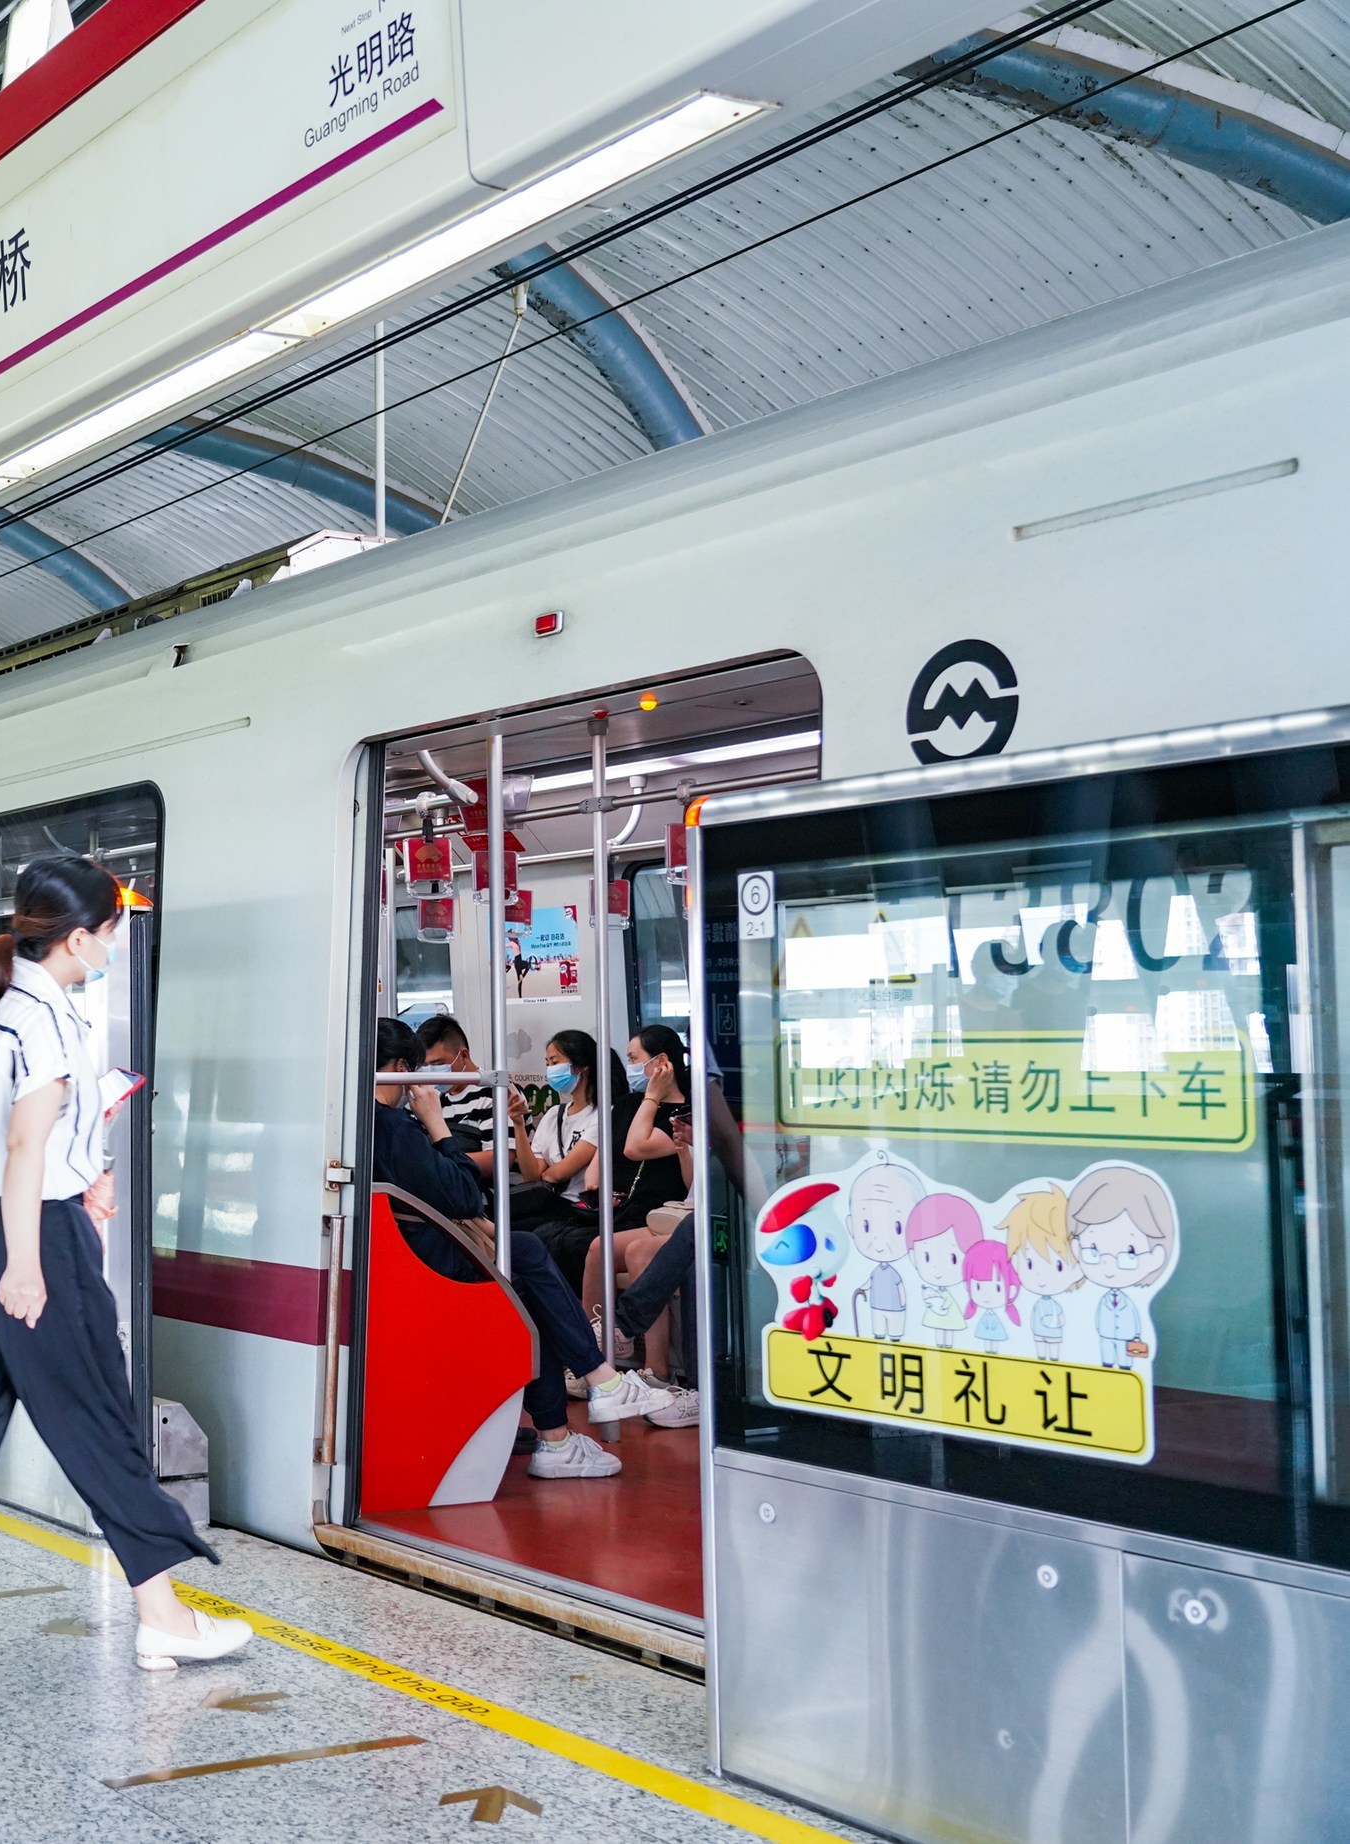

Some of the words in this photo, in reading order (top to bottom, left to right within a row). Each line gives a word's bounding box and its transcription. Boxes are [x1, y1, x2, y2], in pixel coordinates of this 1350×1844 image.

[341, 20, 356, 35] Next
[357, 10, 372, 25] Stop
[328, 12, 415, 108] 光明路
[304, 91, 379, 148] Guangming
[383, 60, 419, 101] Road
[750, 885, 761, 905] 6
[746, 921, 766, 937] 2-1
[514, 1074, 544, 1082] COURTESY
[807, 1342, 1093, 1438] 文明礼让
[263, 1624, 332, 1654] please
[337, 1651, 394, 1678] mind
[392, 1673, 436, 1695] the
[436, 1691, 492, 1719] gap.
